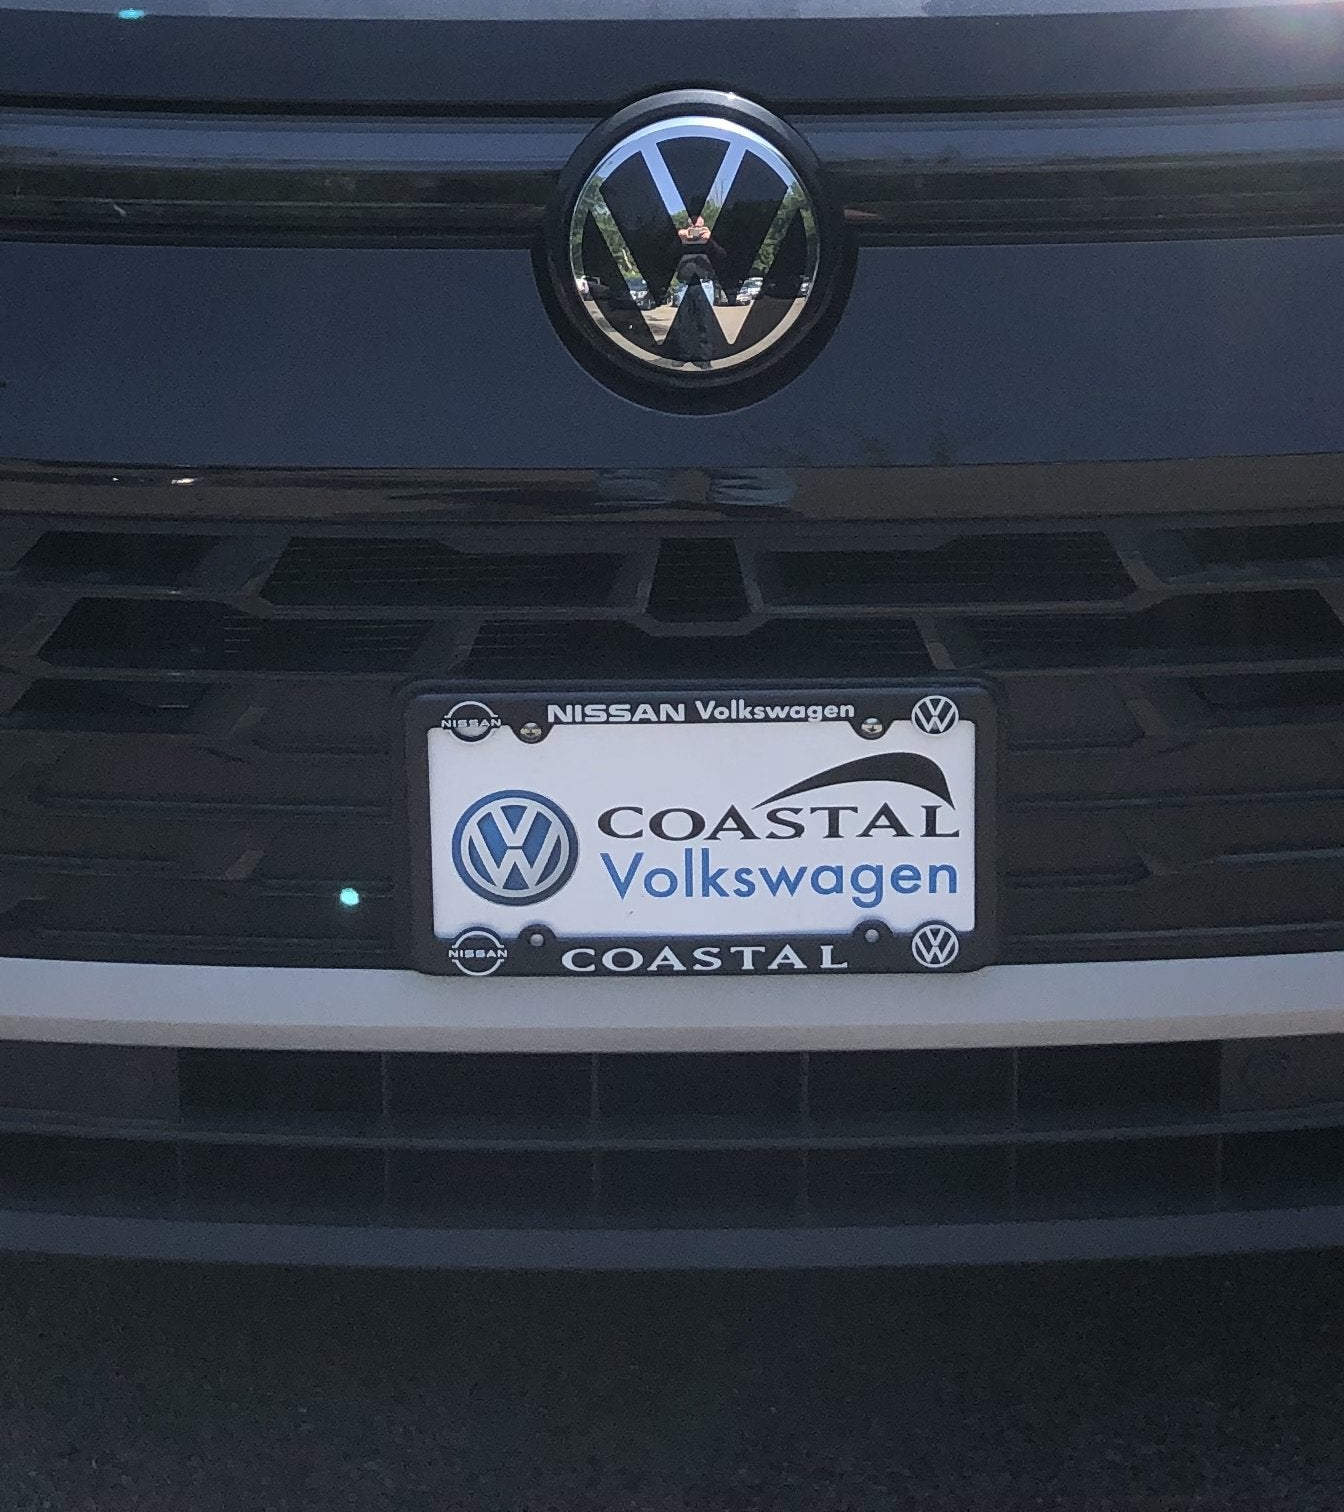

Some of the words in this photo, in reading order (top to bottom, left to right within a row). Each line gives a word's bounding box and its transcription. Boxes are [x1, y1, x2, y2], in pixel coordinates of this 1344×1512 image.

[441, 717, 502, 729] NISSAN
[547, 703, 686, 723] NISSAN
[694, 699, 855, 722] Volkswagen
[596, 803, 960, 842] COASTAL
[599, 848, 958, 909] Volkswagen
[561, 944, 848, 973] COASTAL
